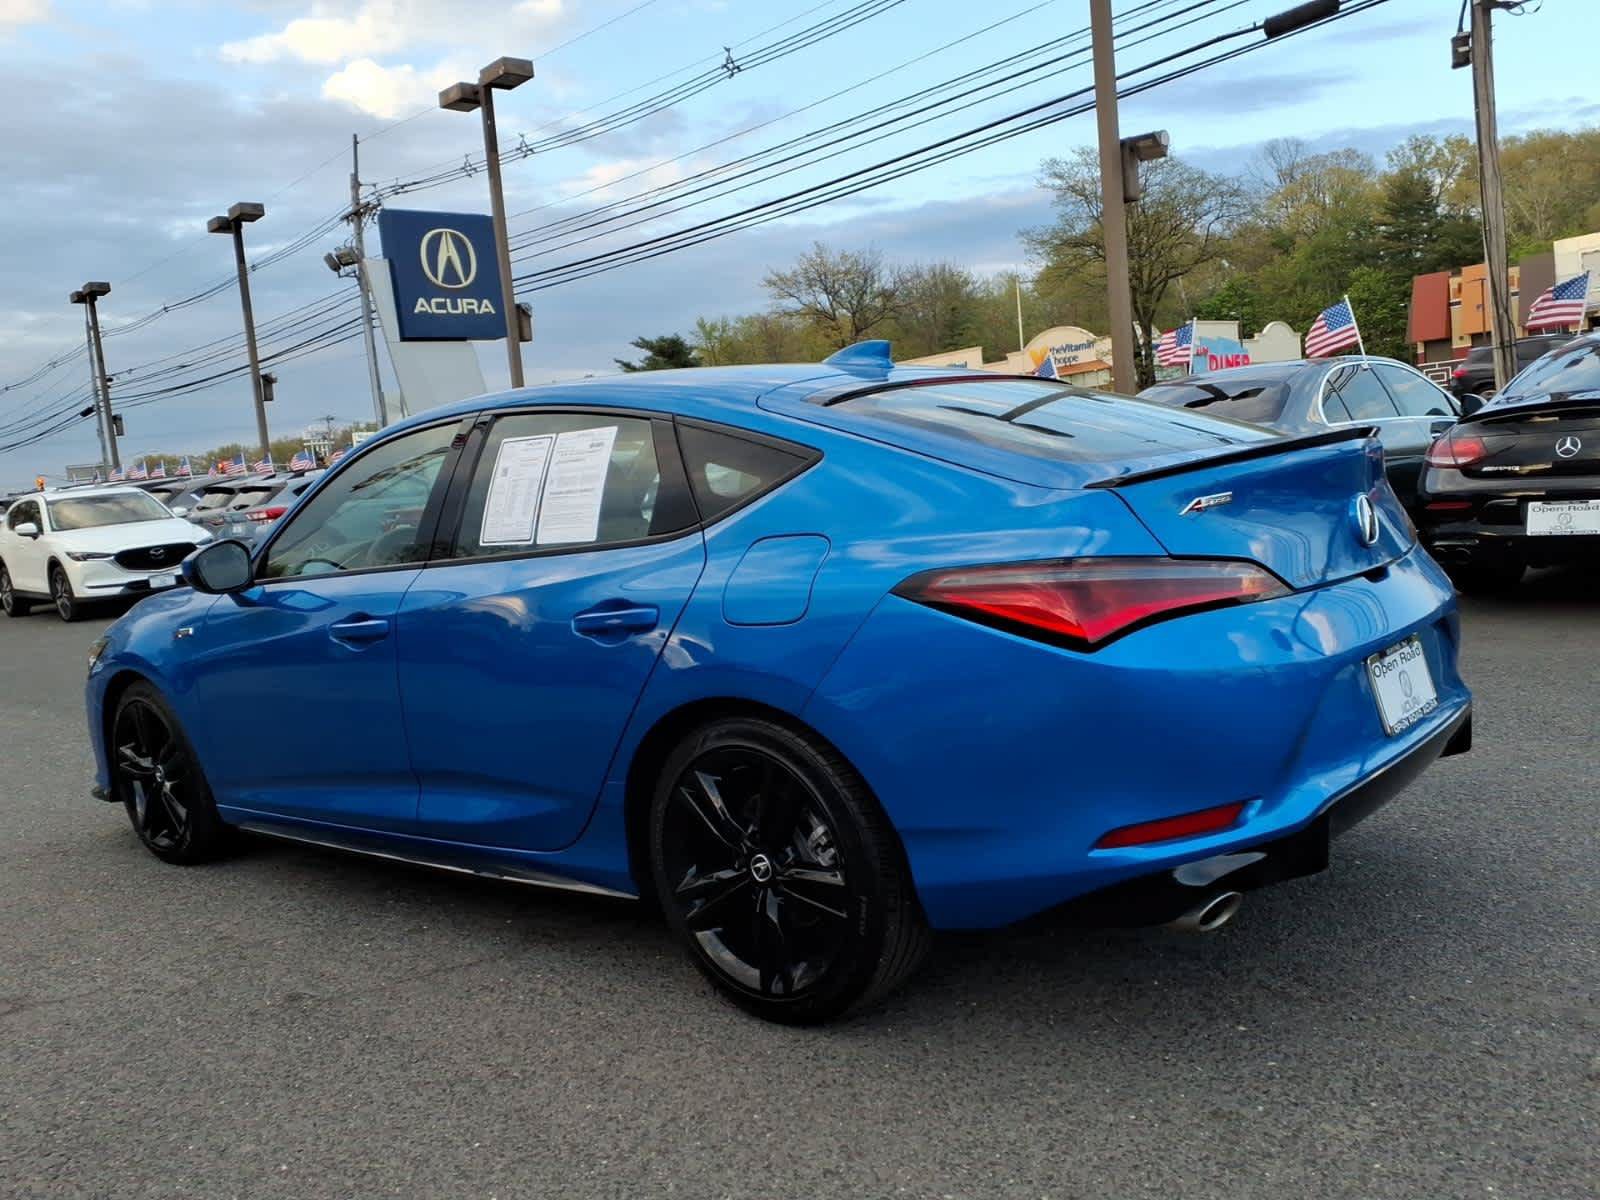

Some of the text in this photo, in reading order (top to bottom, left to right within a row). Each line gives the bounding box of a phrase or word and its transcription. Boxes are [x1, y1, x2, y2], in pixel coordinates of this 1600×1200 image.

[414, 297, 496, 315] ACURA
[1053, 355, 1079, 367] hoppe
[1532, 503, 1600, 513] Open Road
[1372, 658, 1400, 679] Open
[1399, 646, 1422, 664] Road
